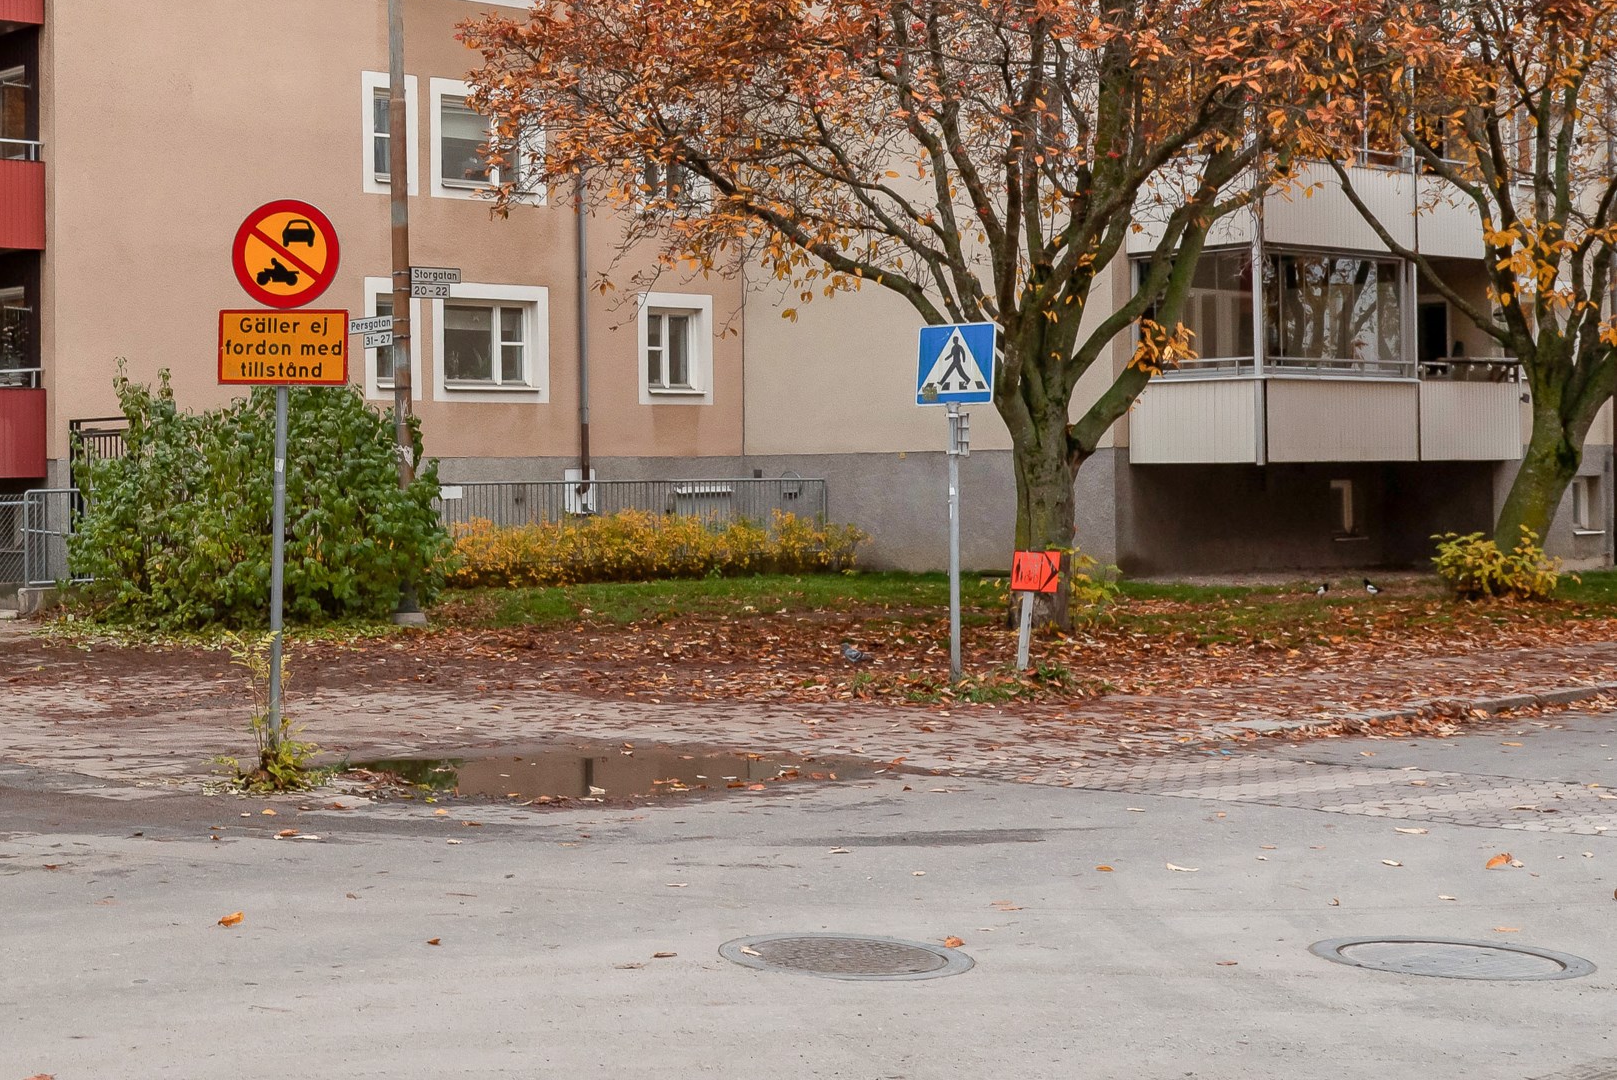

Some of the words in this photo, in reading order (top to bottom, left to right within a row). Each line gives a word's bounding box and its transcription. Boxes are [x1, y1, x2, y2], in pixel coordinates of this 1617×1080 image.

[414, 269, 457, 281] Storgatan
[239, 317, 300, 334] Gäller
[310, 317, 328, 336] ej
[351, 319, 391, 331] Persgatan
[225, 339, 291, 356] fordon
[300, 339, 342, 356] med
[240, 361, 322, 378] tillstånd
